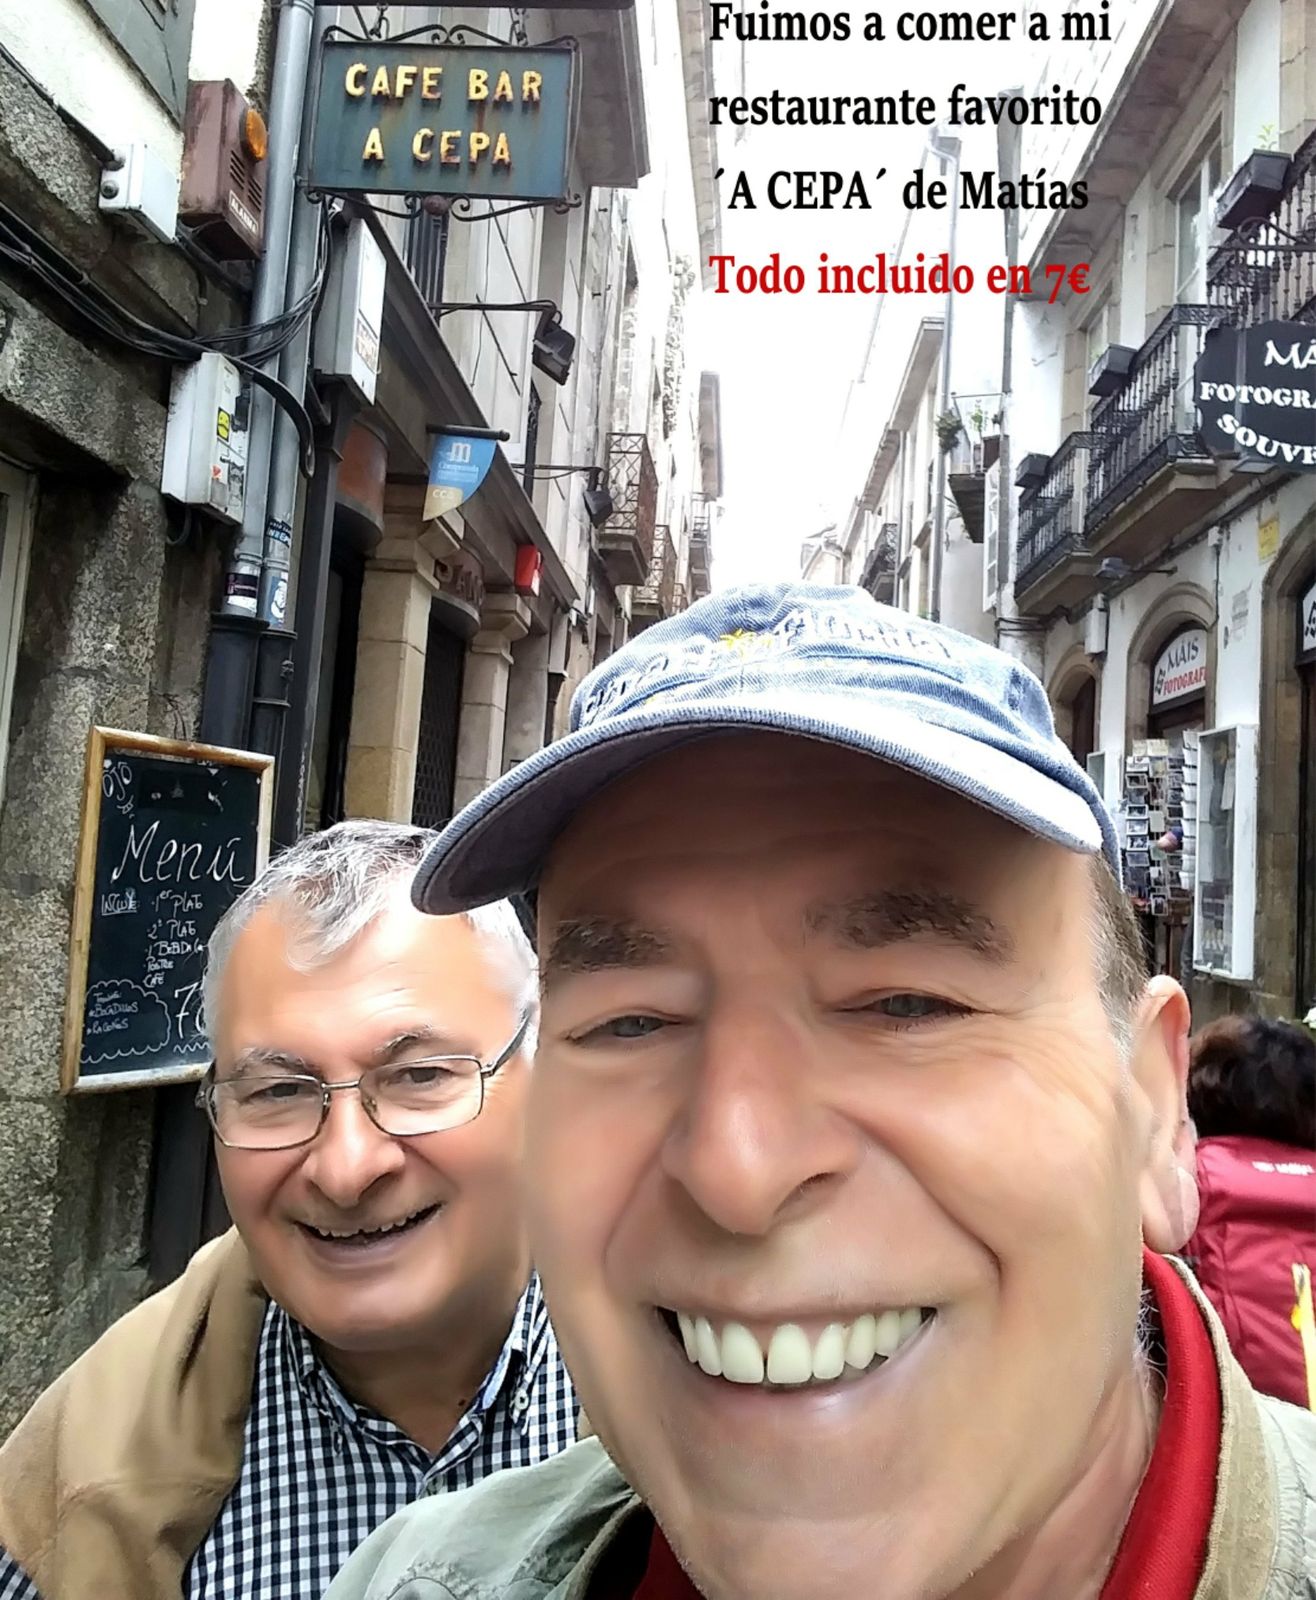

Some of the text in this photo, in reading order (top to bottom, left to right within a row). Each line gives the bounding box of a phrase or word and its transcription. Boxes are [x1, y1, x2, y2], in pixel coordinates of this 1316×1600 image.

[344, 62, 543, 102] CAFE BAR
[362, 127, 512, 164] A CEPA
[1200, 381, 1316, 409] FOTOGR
[110, 820, 245, 884] Menú
